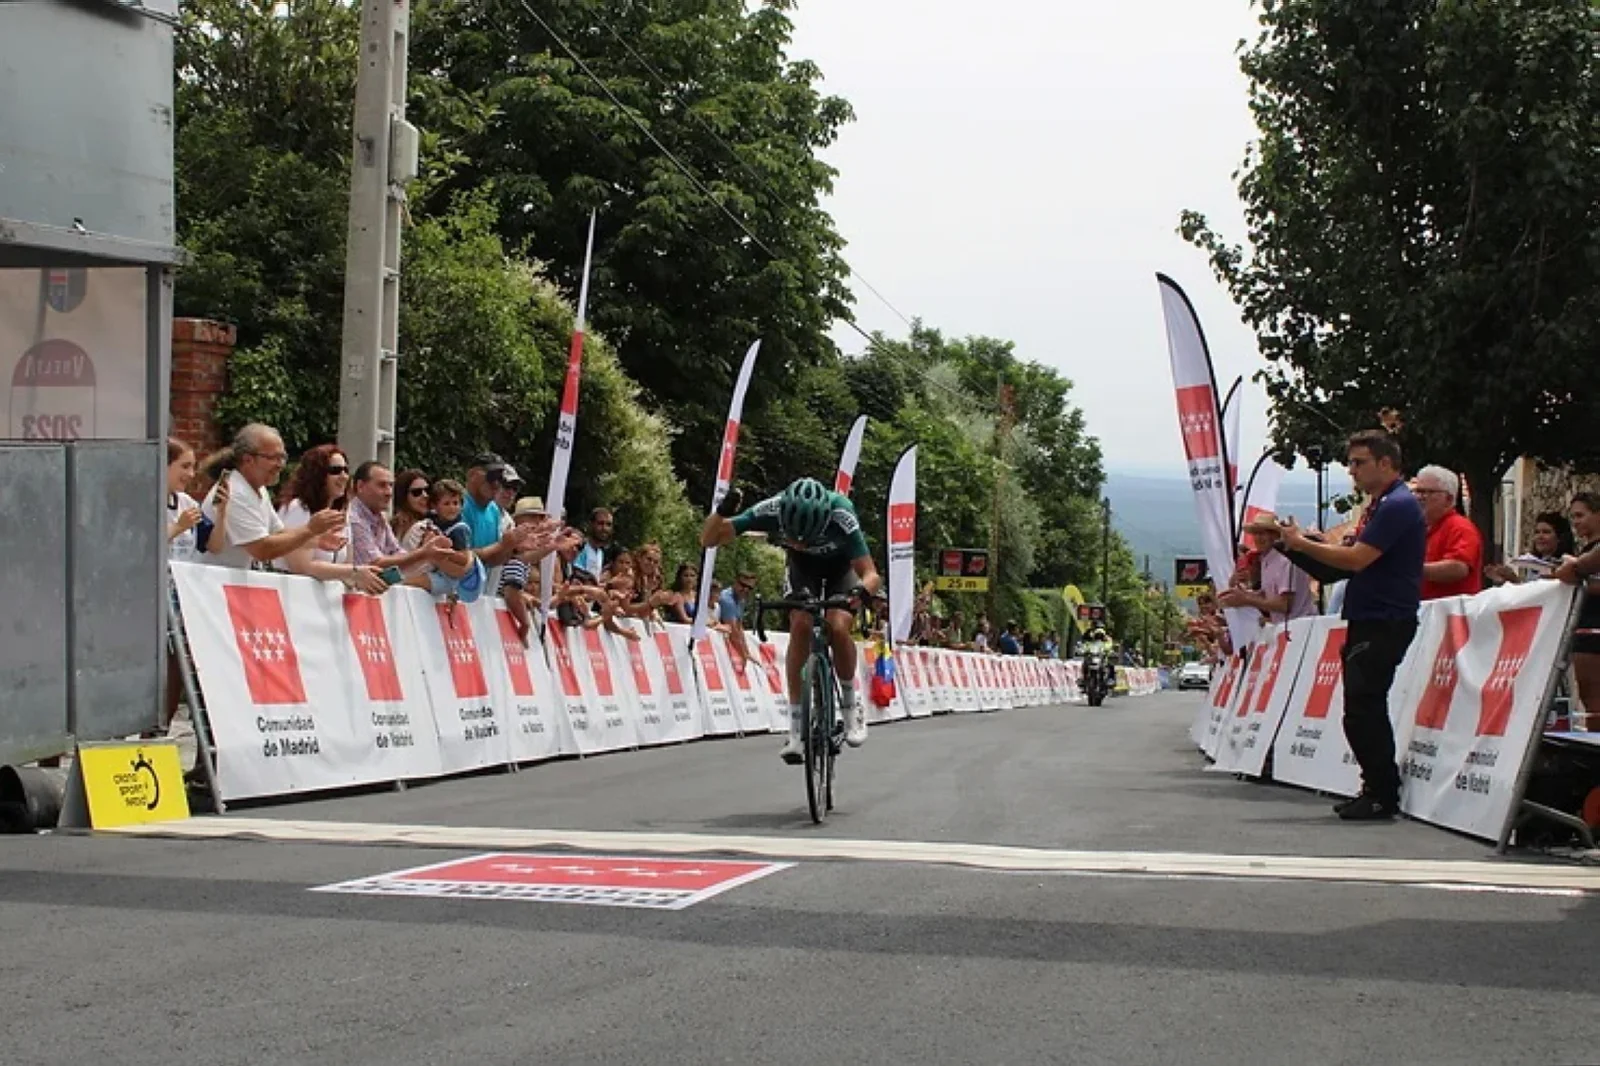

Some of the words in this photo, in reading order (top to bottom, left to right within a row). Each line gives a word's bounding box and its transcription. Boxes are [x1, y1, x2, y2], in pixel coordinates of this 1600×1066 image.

[947, 578, 962, 589] 25
[965, 580, 977, 589] m
[257, 714, 315, 733] Comunidad
[264, 739, 278, 757] de
[279, 736, 320, 756] Madrid
